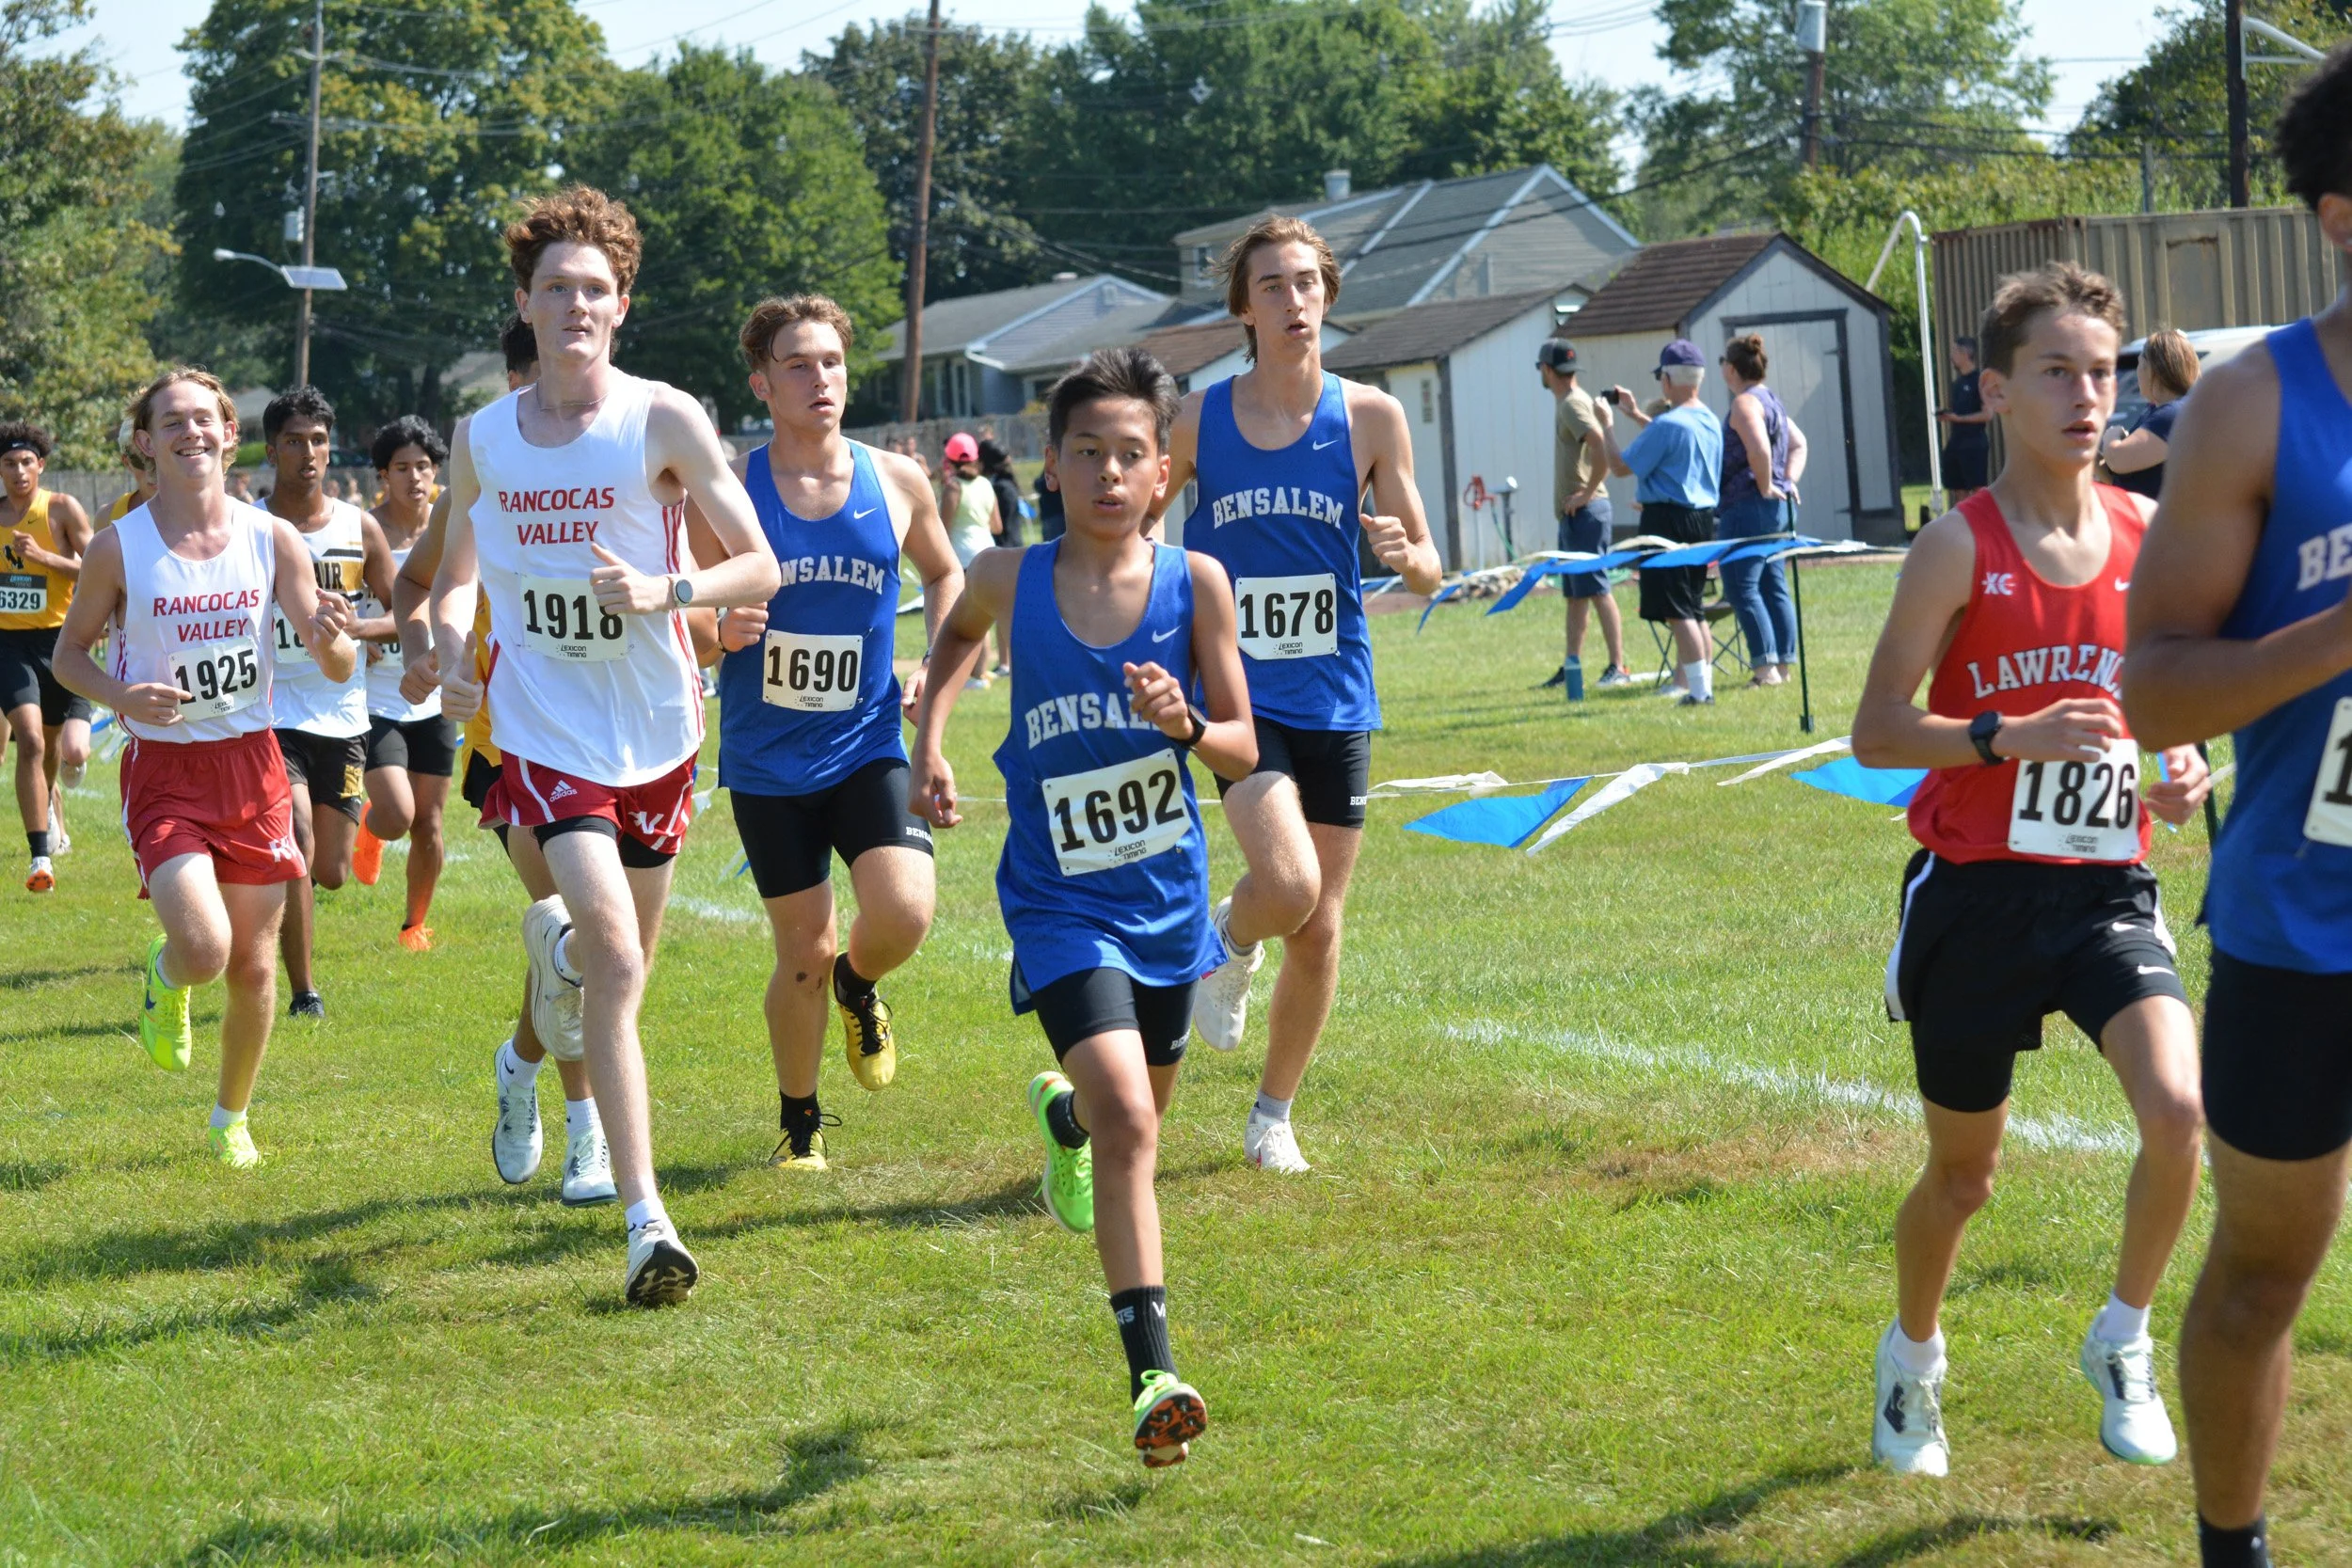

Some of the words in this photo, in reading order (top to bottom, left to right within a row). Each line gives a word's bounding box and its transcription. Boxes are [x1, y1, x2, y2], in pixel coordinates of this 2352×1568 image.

[499, 487, 614, 513] RANCOCAS
[1213, 486, 1344, 531] BENSALEM
[516, 520, 599, 546] VALLEY
[782, 555, 886, 595] NSALEM
[1981, 572, 2015, 595] XC
[153, 589, 260, 617] RANCOCAS
[524, 589, 624, 641] 1918
[1239, 589, 1334, 640] 1678
[177, 617, 249, 642] VALLEY
[175, 649, 257, 705] 1925
[767, 645, 859, 693] 1690
[1967, 644, 2125, 701] LAWRENC
[549, 788, 578, 803] adidas
[1054, 768, 1185, 853] 1692
[2018, 760, 2136, 830] 1826
